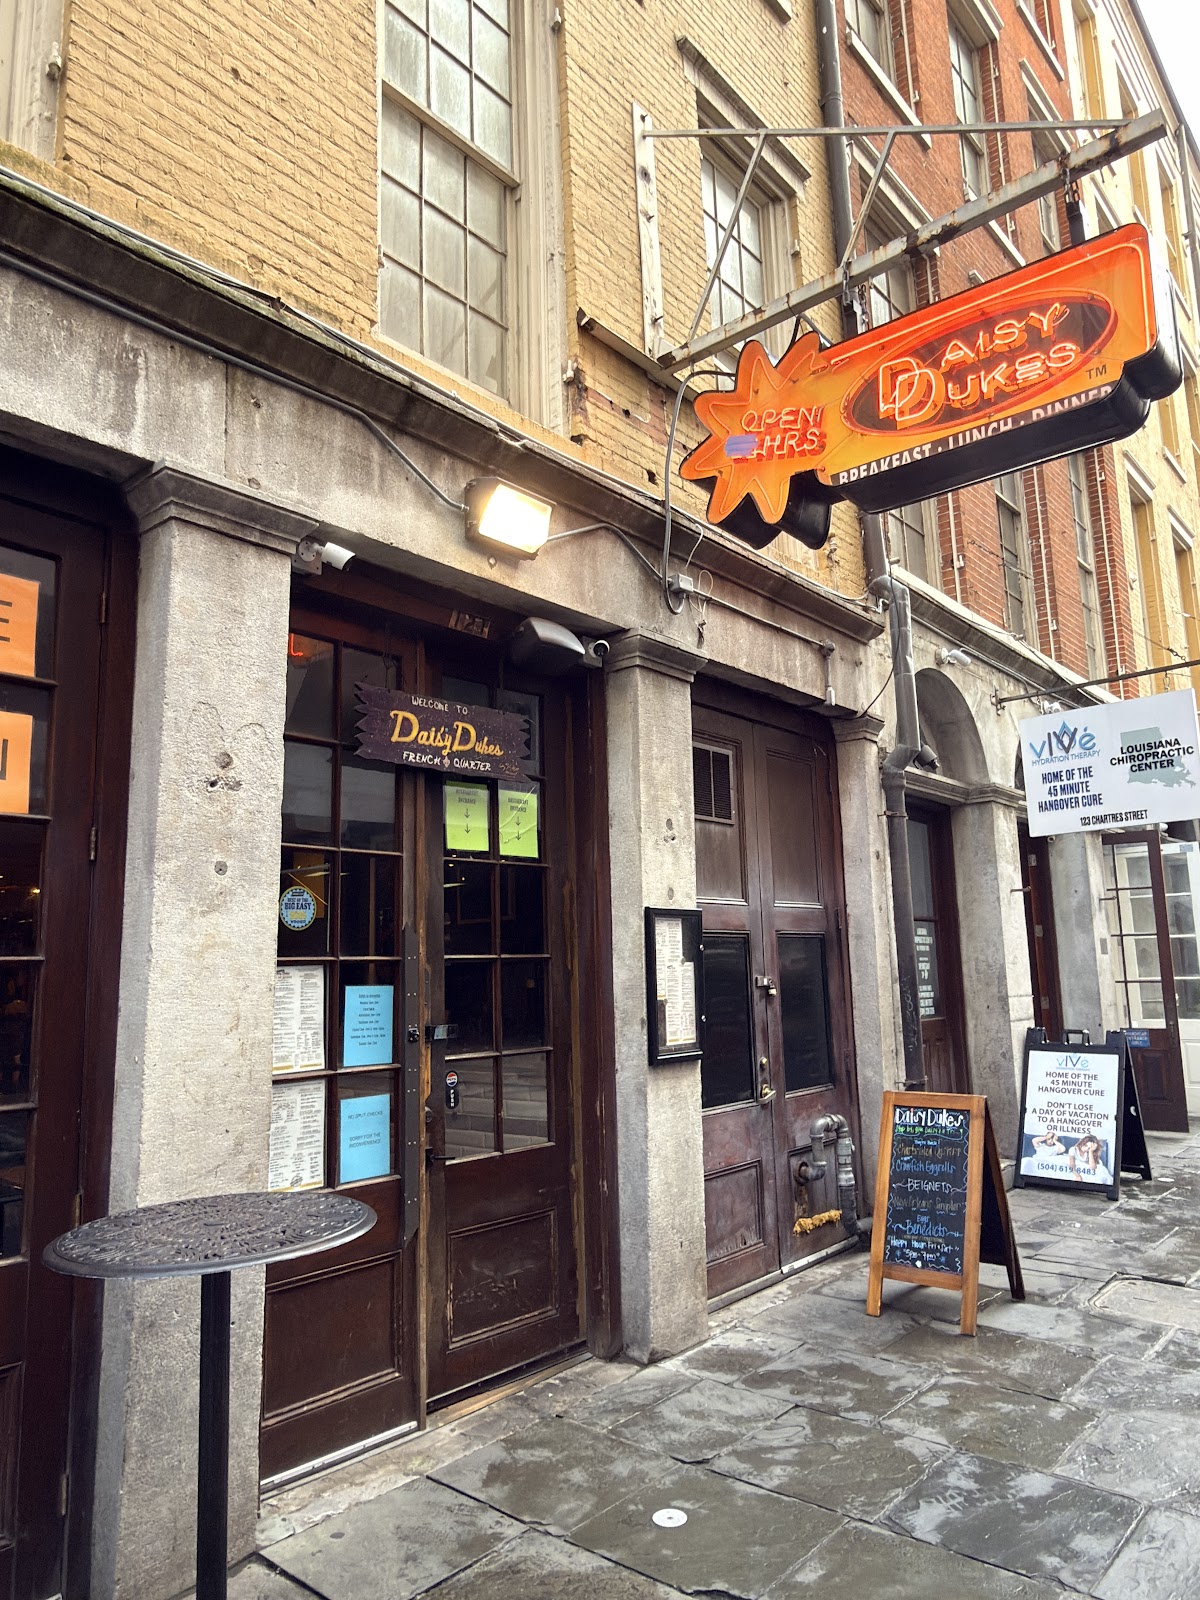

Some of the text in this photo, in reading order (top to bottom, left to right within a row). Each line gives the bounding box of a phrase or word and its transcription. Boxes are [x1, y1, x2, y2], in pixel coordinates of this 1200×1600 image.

[1086, 364, 1107, 380] TM
[411, 695, 468, 715] WELCOME TO
[389, 709, 504, 756] Daisy Dukes
[1120, 738, 1181, 755] LOUISIANA
[403, 750, 441, 766] FRENCH
[453, 758, 491, 772] QUARTER
[1031, 749, 1101, 767] HYDRATION THERAPY
[1109, 746, 1194, 766] CHIROPRACTIC
[1130, 758, 1175, 773] CENTER
[1041, 765, 1094, 785] HOME OF THE
[1047, 780, 1091, 797] 45 MINUTE
[1037, 793, 1103, 813] HANGOVER CURE
[1080, 809, 1148, 826] 123 CHARTRES STREET
[284, 902, 311, 910] BIG EASY
[1045, 1071, 1099, 1081] HOME OF THE
[1061, 1080, 1093, 1088] MINUTE
[1037, 1086, 1105, 1097] HANGOVER CURE
[1031, 1107, 1109, 1120] A DAY OF VACATION
[1047, 1101, 1094, 1111] DON'T LOSE
[895, 1108, 964, 1127] Daisy Dukes
[1037, 1115, 1048, 1123] TO
[1056, 1117, 1102, 1128] HANGOVER
[1059, 1125, 1091, 1134] ILLNESS
[1037, 1163, 1057, 1172] (504)
[907, 1178, 952, 1194] BEIGNETS
[906, 1219, 948, 1237] Benedicts
